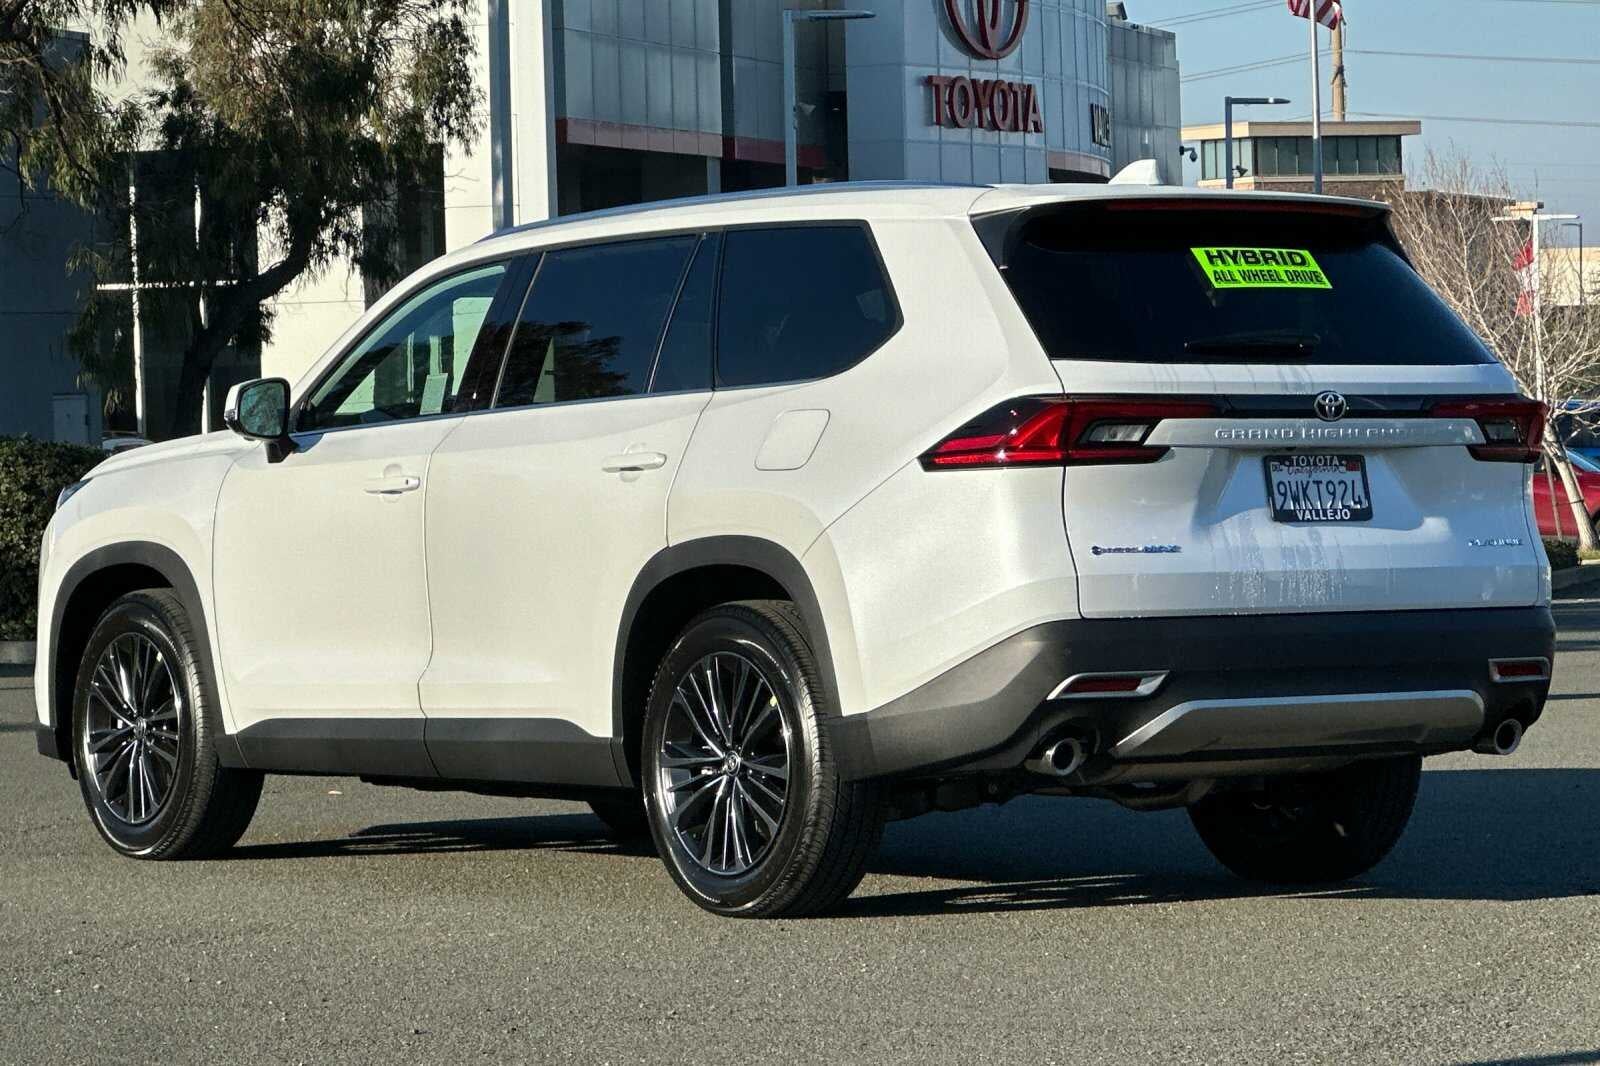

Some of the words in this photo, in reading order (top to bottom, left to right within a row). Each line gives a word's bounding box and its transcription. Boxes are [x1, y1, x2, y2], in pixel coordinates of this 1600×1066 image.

[927, 75, 1043, 133] TOYOTA
[1203, 249, 1308, 267] HYBRID
[1213, 269, 1238, 283] ALL
[1239, 269, 1285, 283] WHEEL
[1285, 270, 1324, 283] DRIVE
[1214, 428, 1294, 439] GRAND
[1291, 455, 1340, 466] TOYOTA
[1276, 480, 1363, 511] 9WKT924
[1296, 509, 1351, 521] VALLEJO
